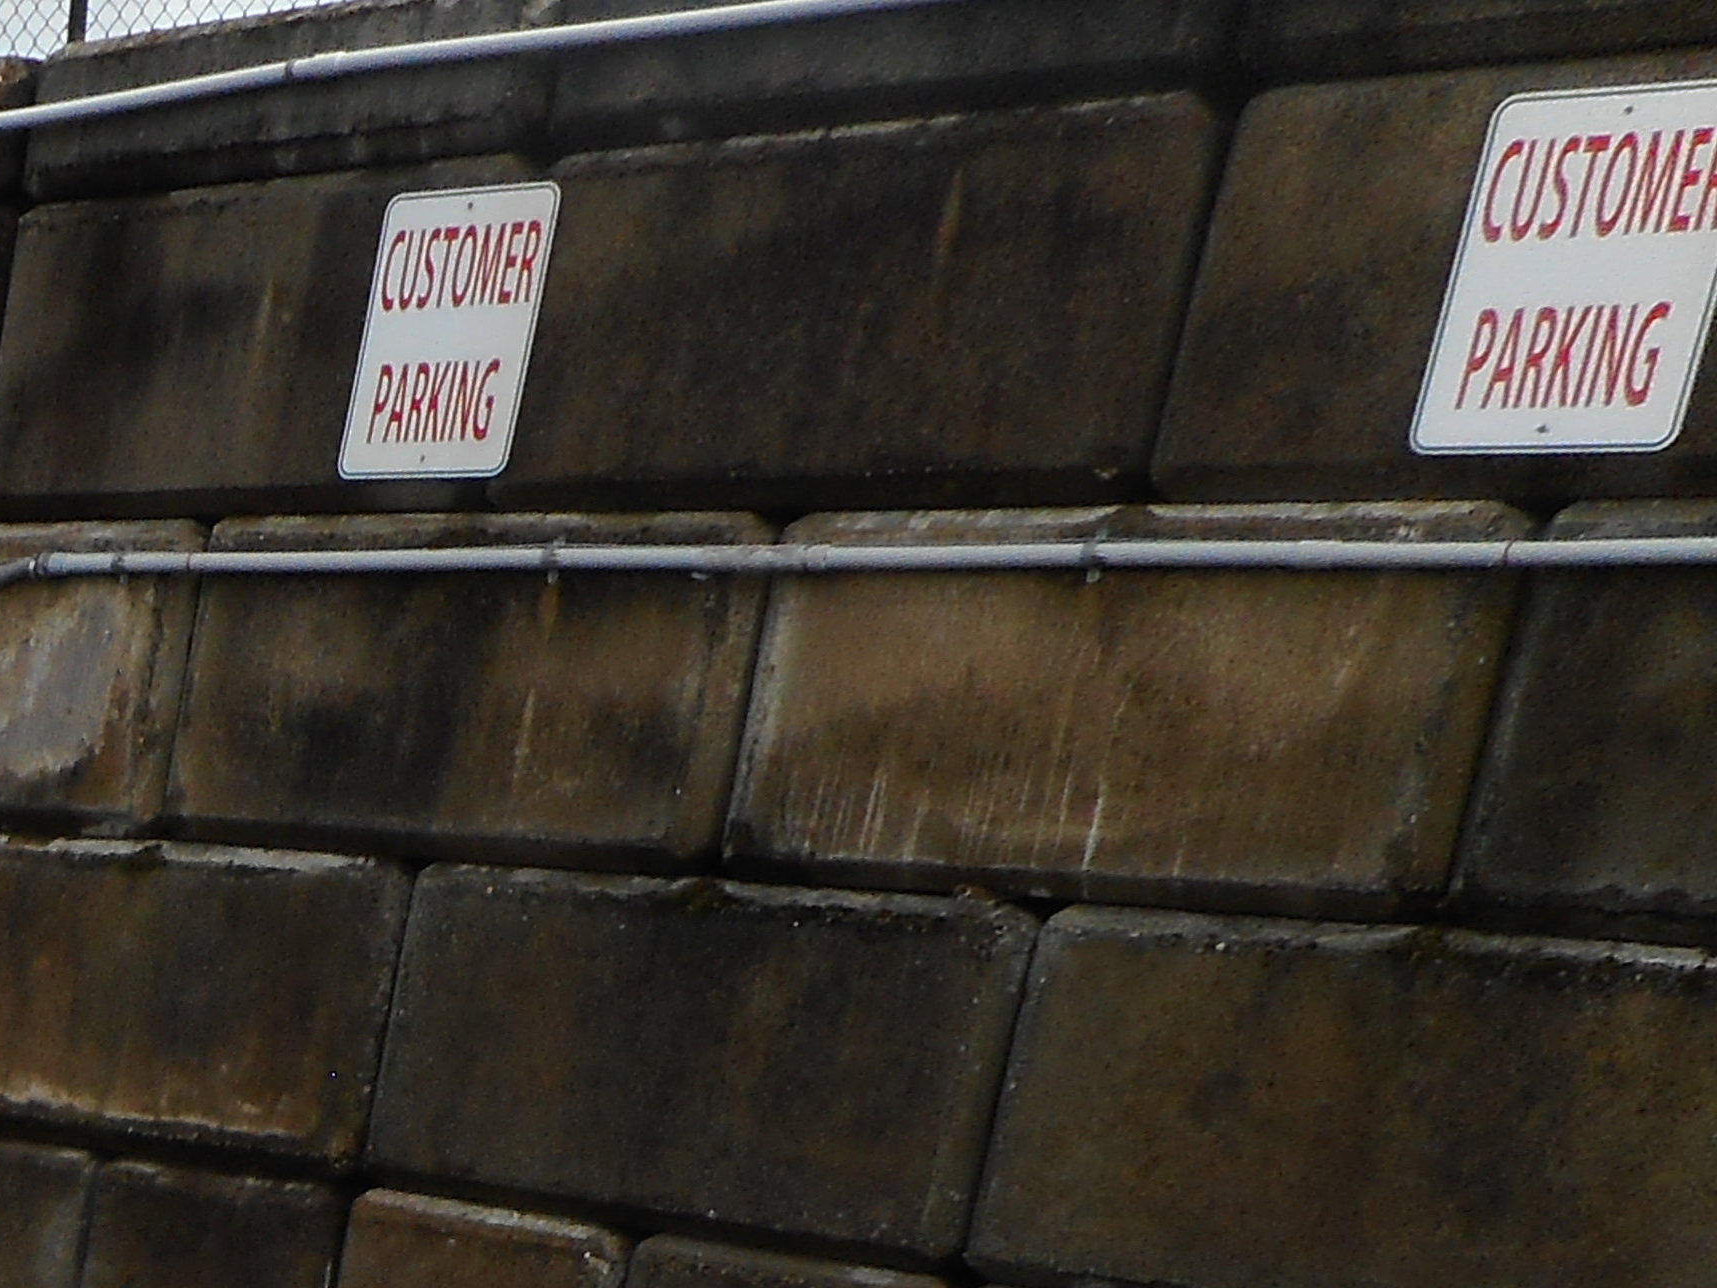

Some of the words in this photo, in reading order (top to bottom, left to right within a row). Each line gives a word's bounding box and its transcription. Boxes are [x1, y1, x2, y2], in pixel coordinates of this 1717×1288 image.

[381, 219, 543, 312] CUSTOMER
[365, 358, 501, 444] PARKING
[1454, 301, 1672, 411] PARKING
